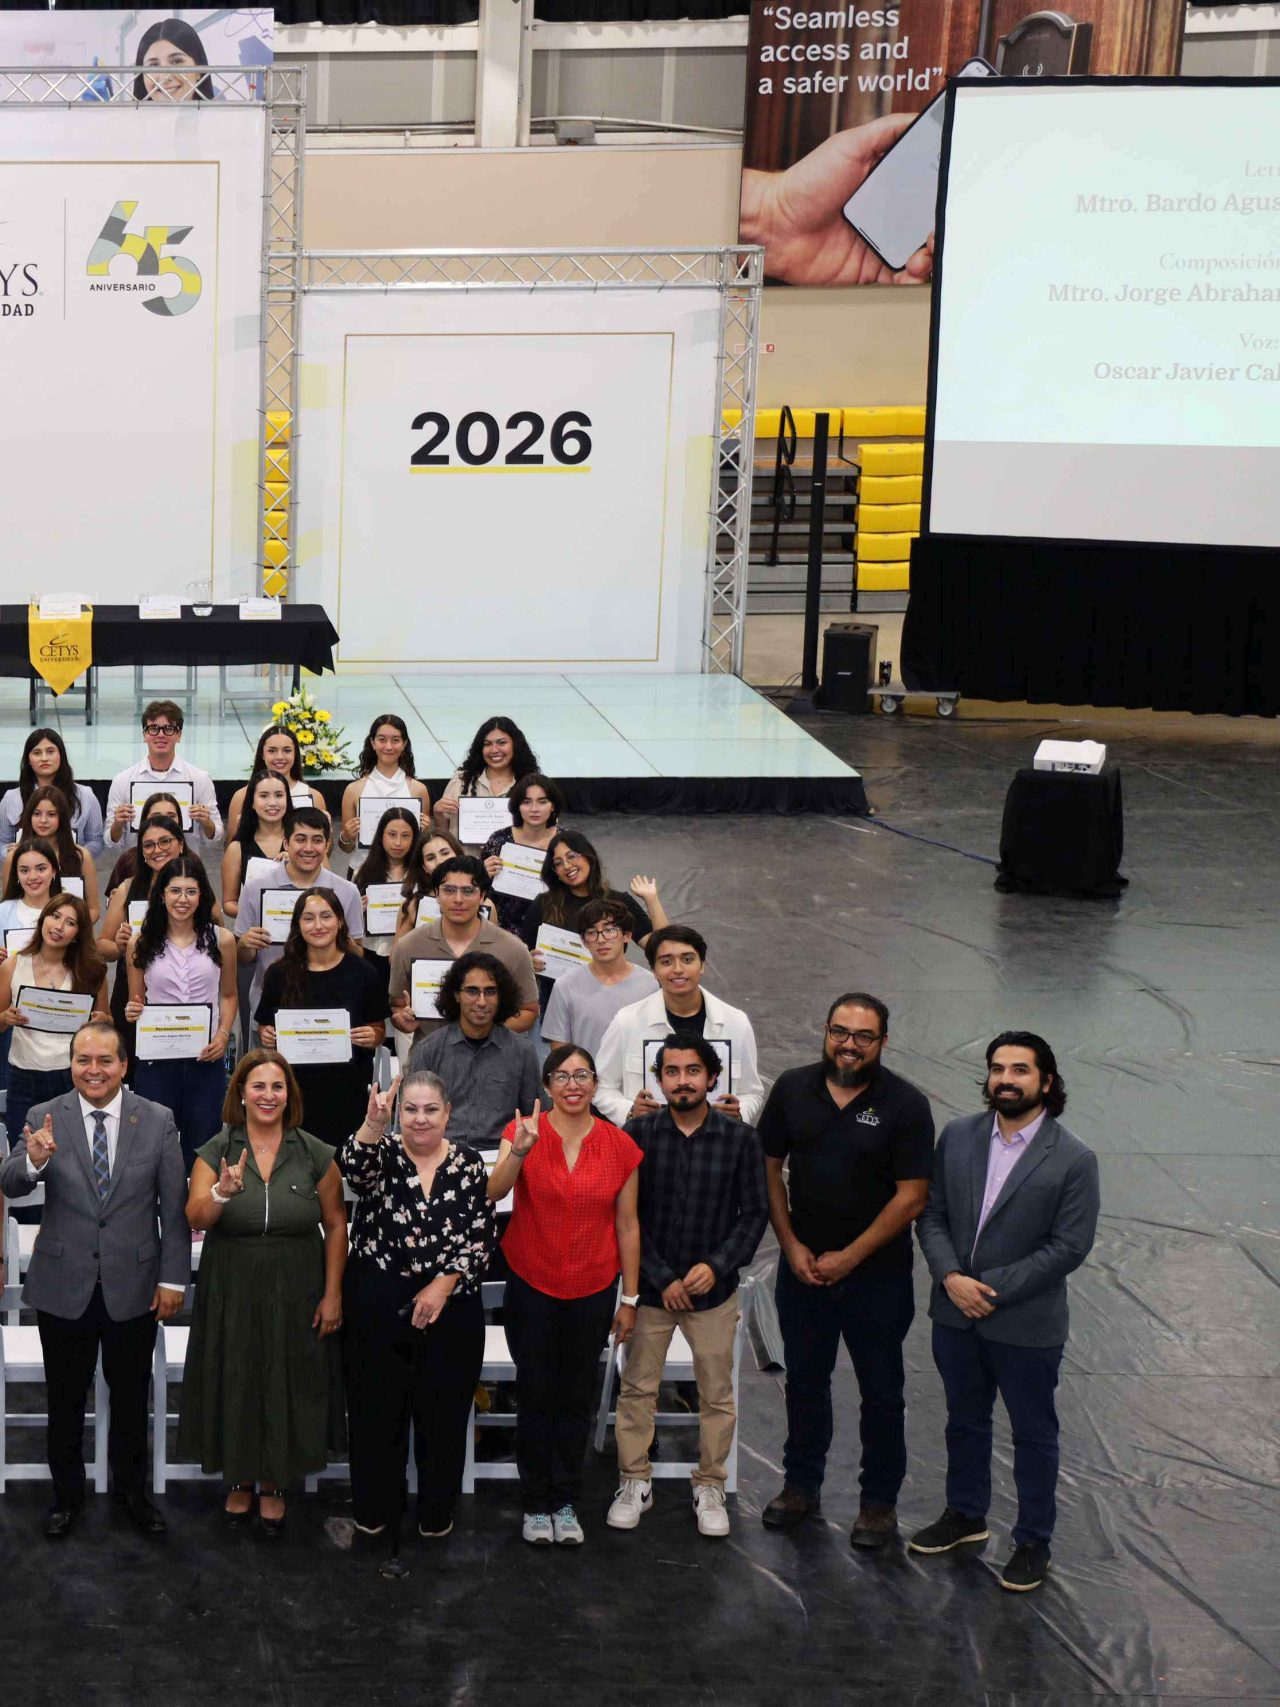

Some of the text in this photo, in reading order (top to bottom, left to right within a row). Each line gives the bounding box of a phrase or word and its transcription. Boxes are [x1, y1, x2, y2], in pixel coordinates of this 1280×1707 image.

[763, 5, 900, 30] “Seamless
[760, 36, 909, 62] access and
[758, 67, 943, 95] a safer world”
[1075, 194, 1138, 213] Mtro.
[1145, 192, 1217, 213] Bardo
[86, 200, 202, 317] 65
[89, 283, 156, 292] ANIVERSARIO
[1047, 284, 1109, 302] Mtro.
[1114, 284, 1182, 306] Jorge
[1238, 333, 1279, 350] Voz:
[1094, 362, 1162, 380] Oscar
[1165, 362, 1240, 381] Javier
[410, 410, 593, 466] 2026
[39, 644, 79, 657] CETYS
